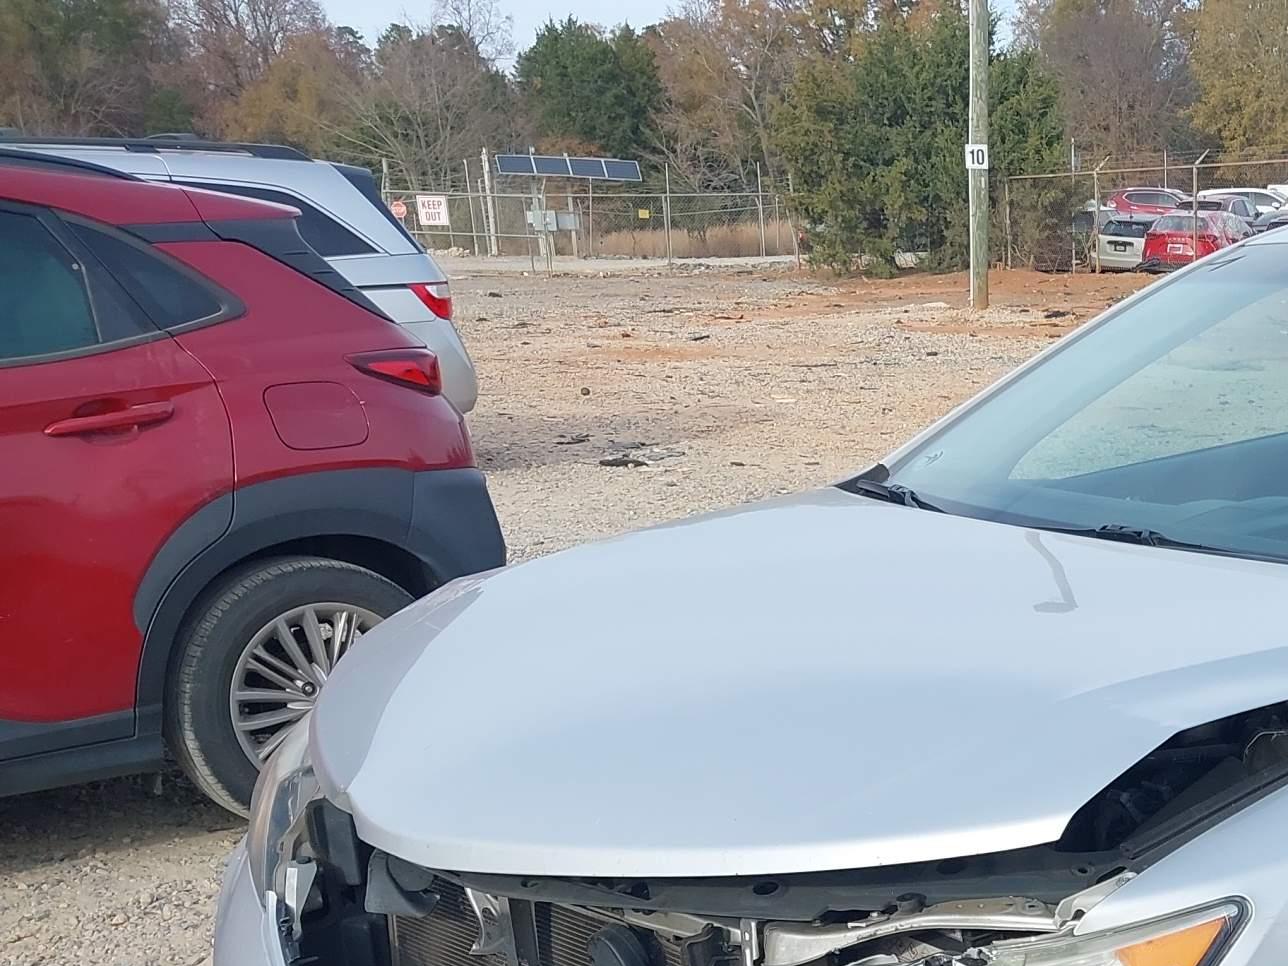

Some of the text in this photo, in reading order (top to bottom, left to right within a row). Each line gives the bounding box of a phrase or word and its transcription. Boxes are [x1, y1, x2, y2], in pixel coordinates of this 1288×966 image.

[969, 148, 985, 166] 10
[421, 199, 442, 210] KEEP
[425, 211, 441, 221] OUT
